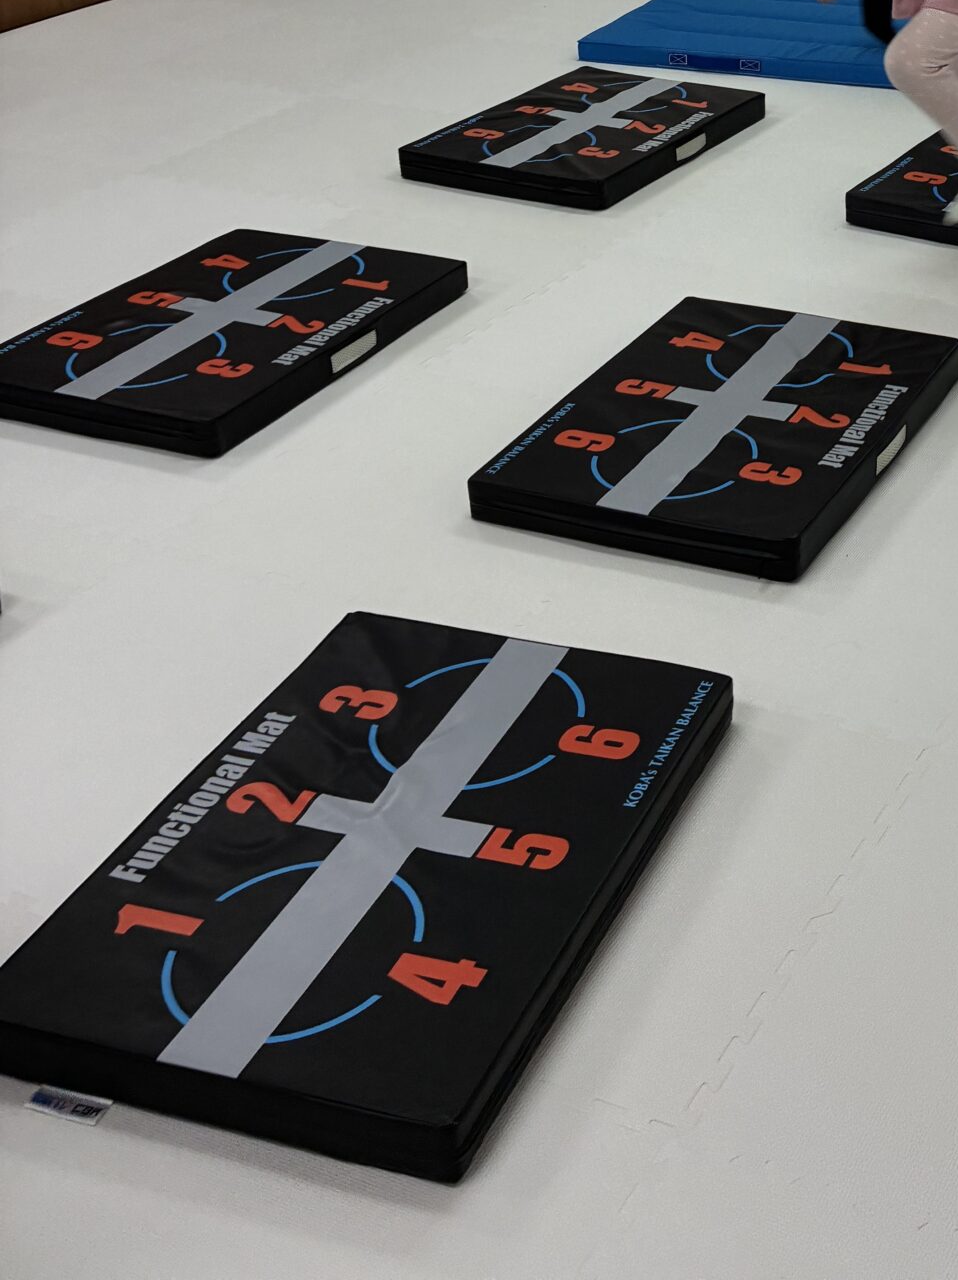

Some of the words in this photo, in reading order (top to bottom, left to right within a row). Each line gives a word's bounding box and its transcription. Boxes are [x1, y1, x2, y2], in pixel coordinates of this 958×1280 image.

[463, 129, 504, 140] 6
[625, 120, 666, 135] 2
[577, 146, 619, 159] 3
[903, 171, 947, 185] 6
[201, 254, 249, 270] 4
[341, 278, 389, 292] 1
[127, 291, 183, 308] 5
[267, 314, 325, 334] 2
[303, 297, 394, 346] Functional
[46, 330, 104, 350] 6
[669, 331, 725, 352] 4
[271, 344, 318, 366] Mat
[195, 358, 255, 379] 3
[838, 361, 893, 375] 1
[614, 378, 674, 399] 5
[788, 405, 851, 429] 2
[839, 384, 909, 445] Functional
[553, 429, 616, 453] 6
[818, 444, 859, 468] Mat
[738, 461, 803, 486] 3
[318, 684, 399, 721] 3
[649, 727, 684, 766] TAIKAN
[676, 680, 714, 726] BALANCE
[557, 724, 641, 760] 6
[108, 754, 256, 883] Functional
[232, 711, 297, 755] Mat
[226, 781, 317, 824] 2
[476, 827, 570, 870] 5
[114, 903, 204, 937] 1
[386, 952, 488, 1006] 4
